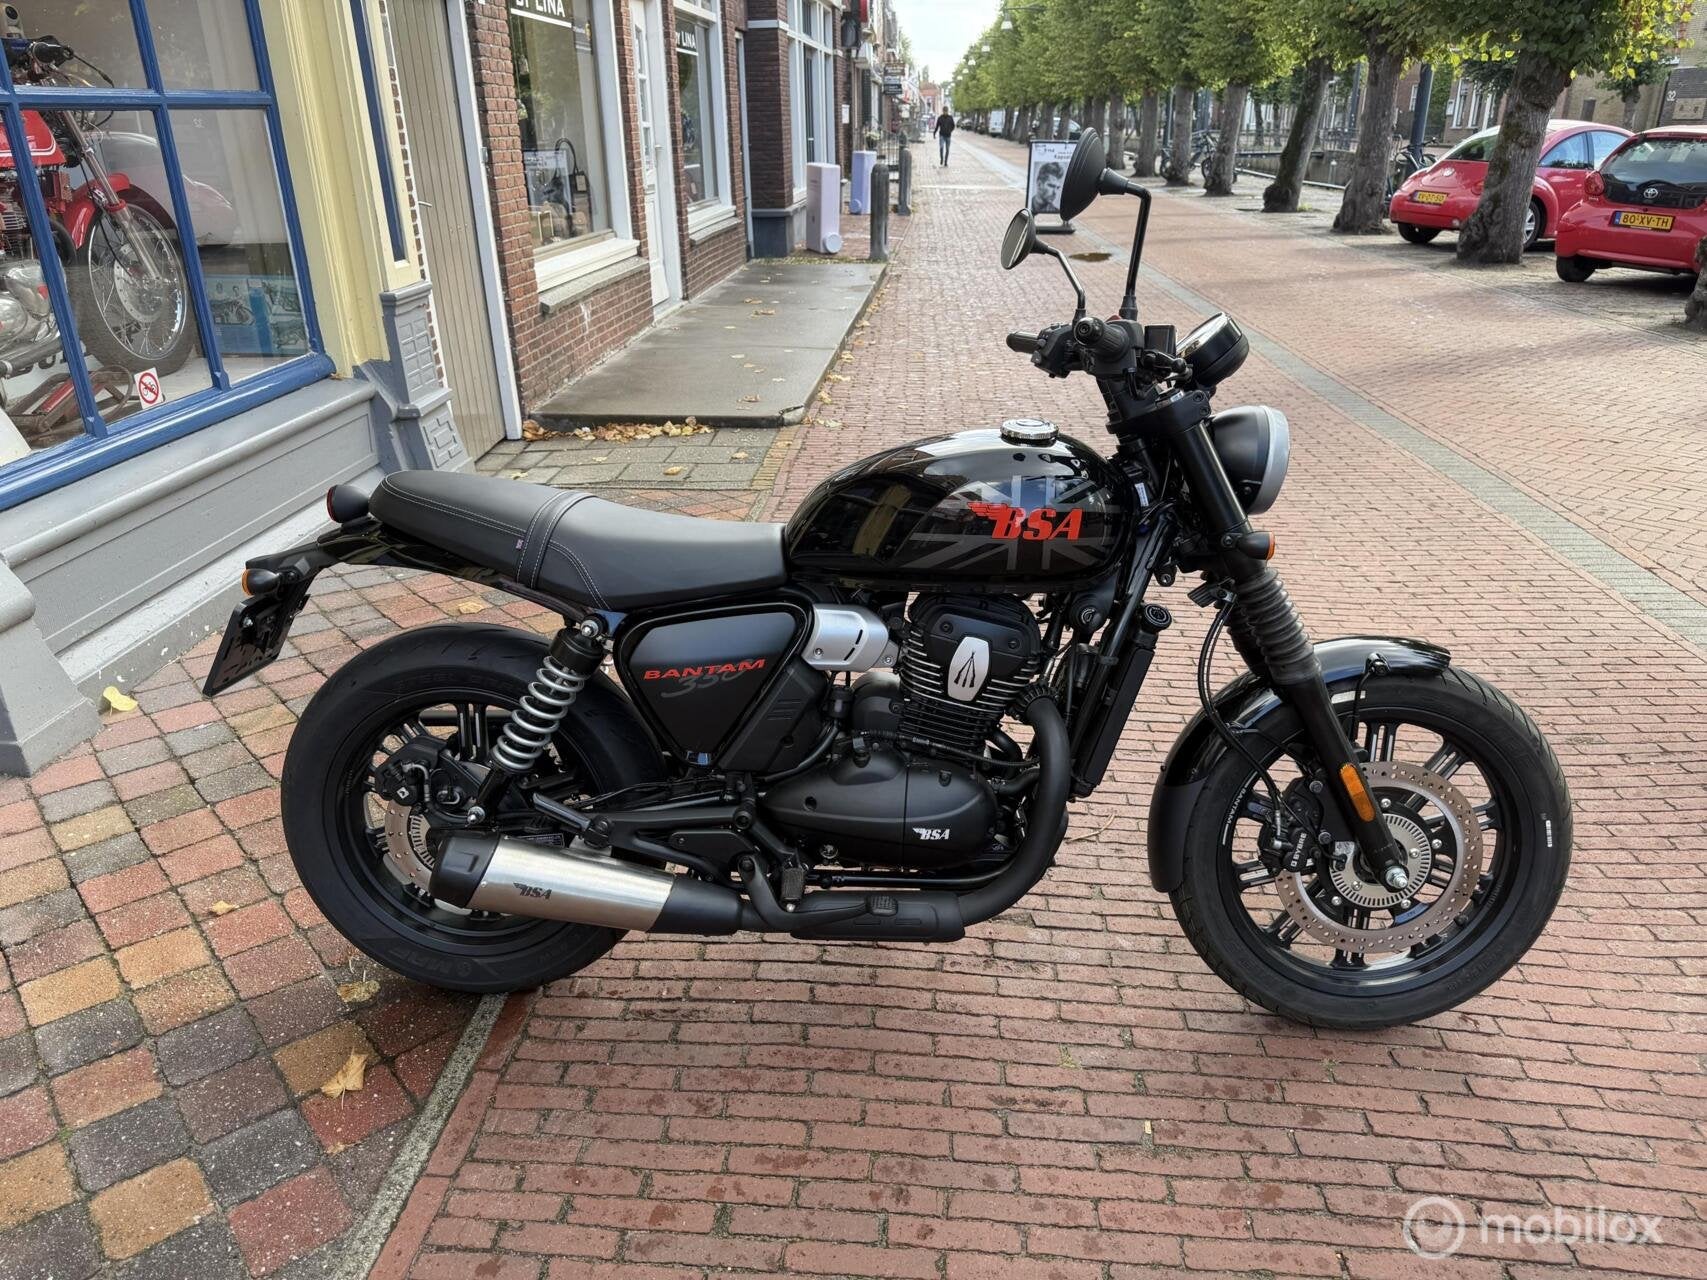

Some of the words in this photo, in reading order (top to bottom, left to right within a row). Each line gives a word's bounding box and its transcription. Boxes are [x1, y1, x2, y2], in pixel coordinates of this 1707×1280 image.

[535, 0, 566, 18] LINA
[991, 503, 1084, 541] BSA
[644, 659, 766, 680] BANTAM
[920, 828, 950, 840] BSA
[519, 885, 553, 900] BSA
